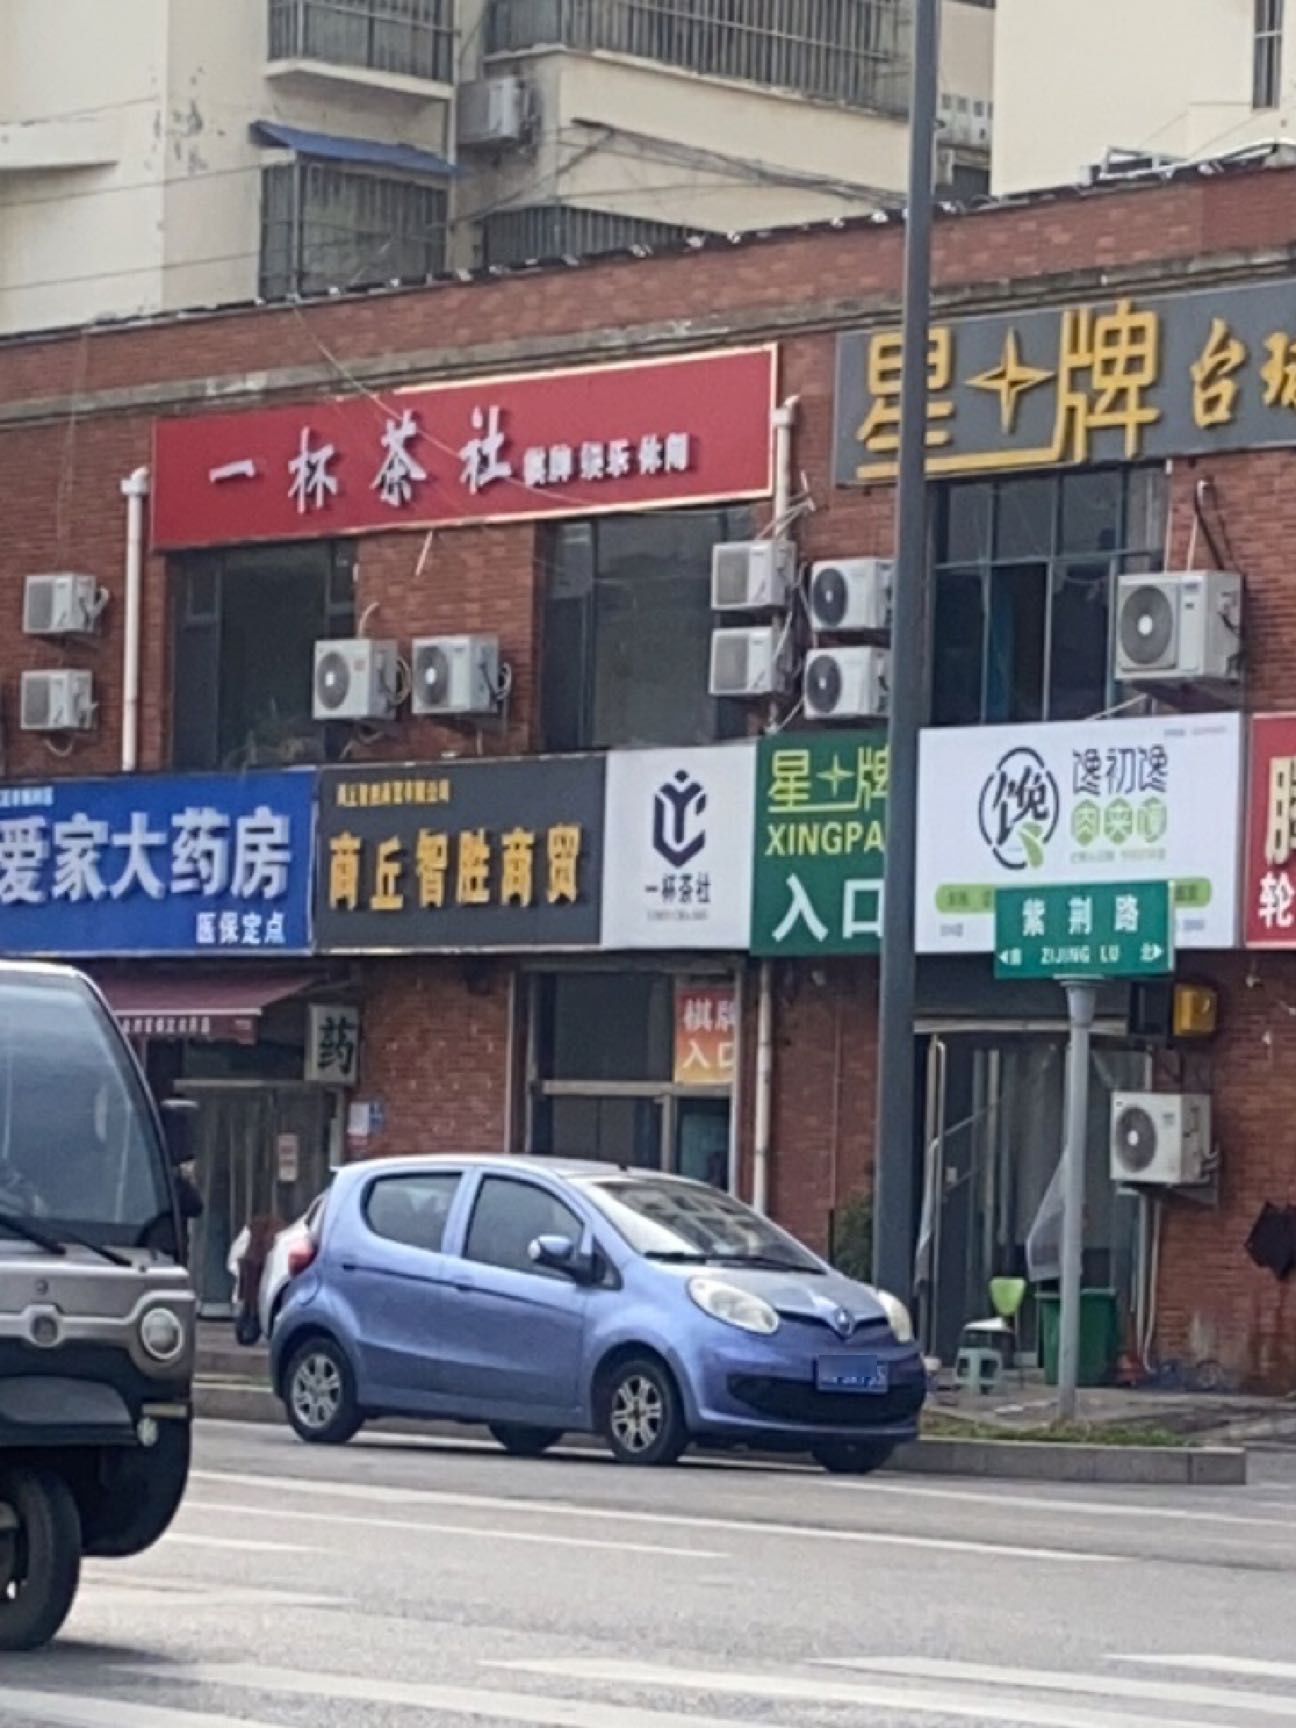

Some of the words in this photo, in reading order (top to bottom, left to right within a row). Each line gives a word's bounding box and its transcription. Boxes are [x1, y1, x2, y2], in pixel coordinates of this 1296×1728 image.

[209, 405, 512, 514] 一杯茶社
[196, 912, 286, 944] 医保定点
[771, 873, 885, 942] 入口
[317, 1016, 355, 1074] 药
